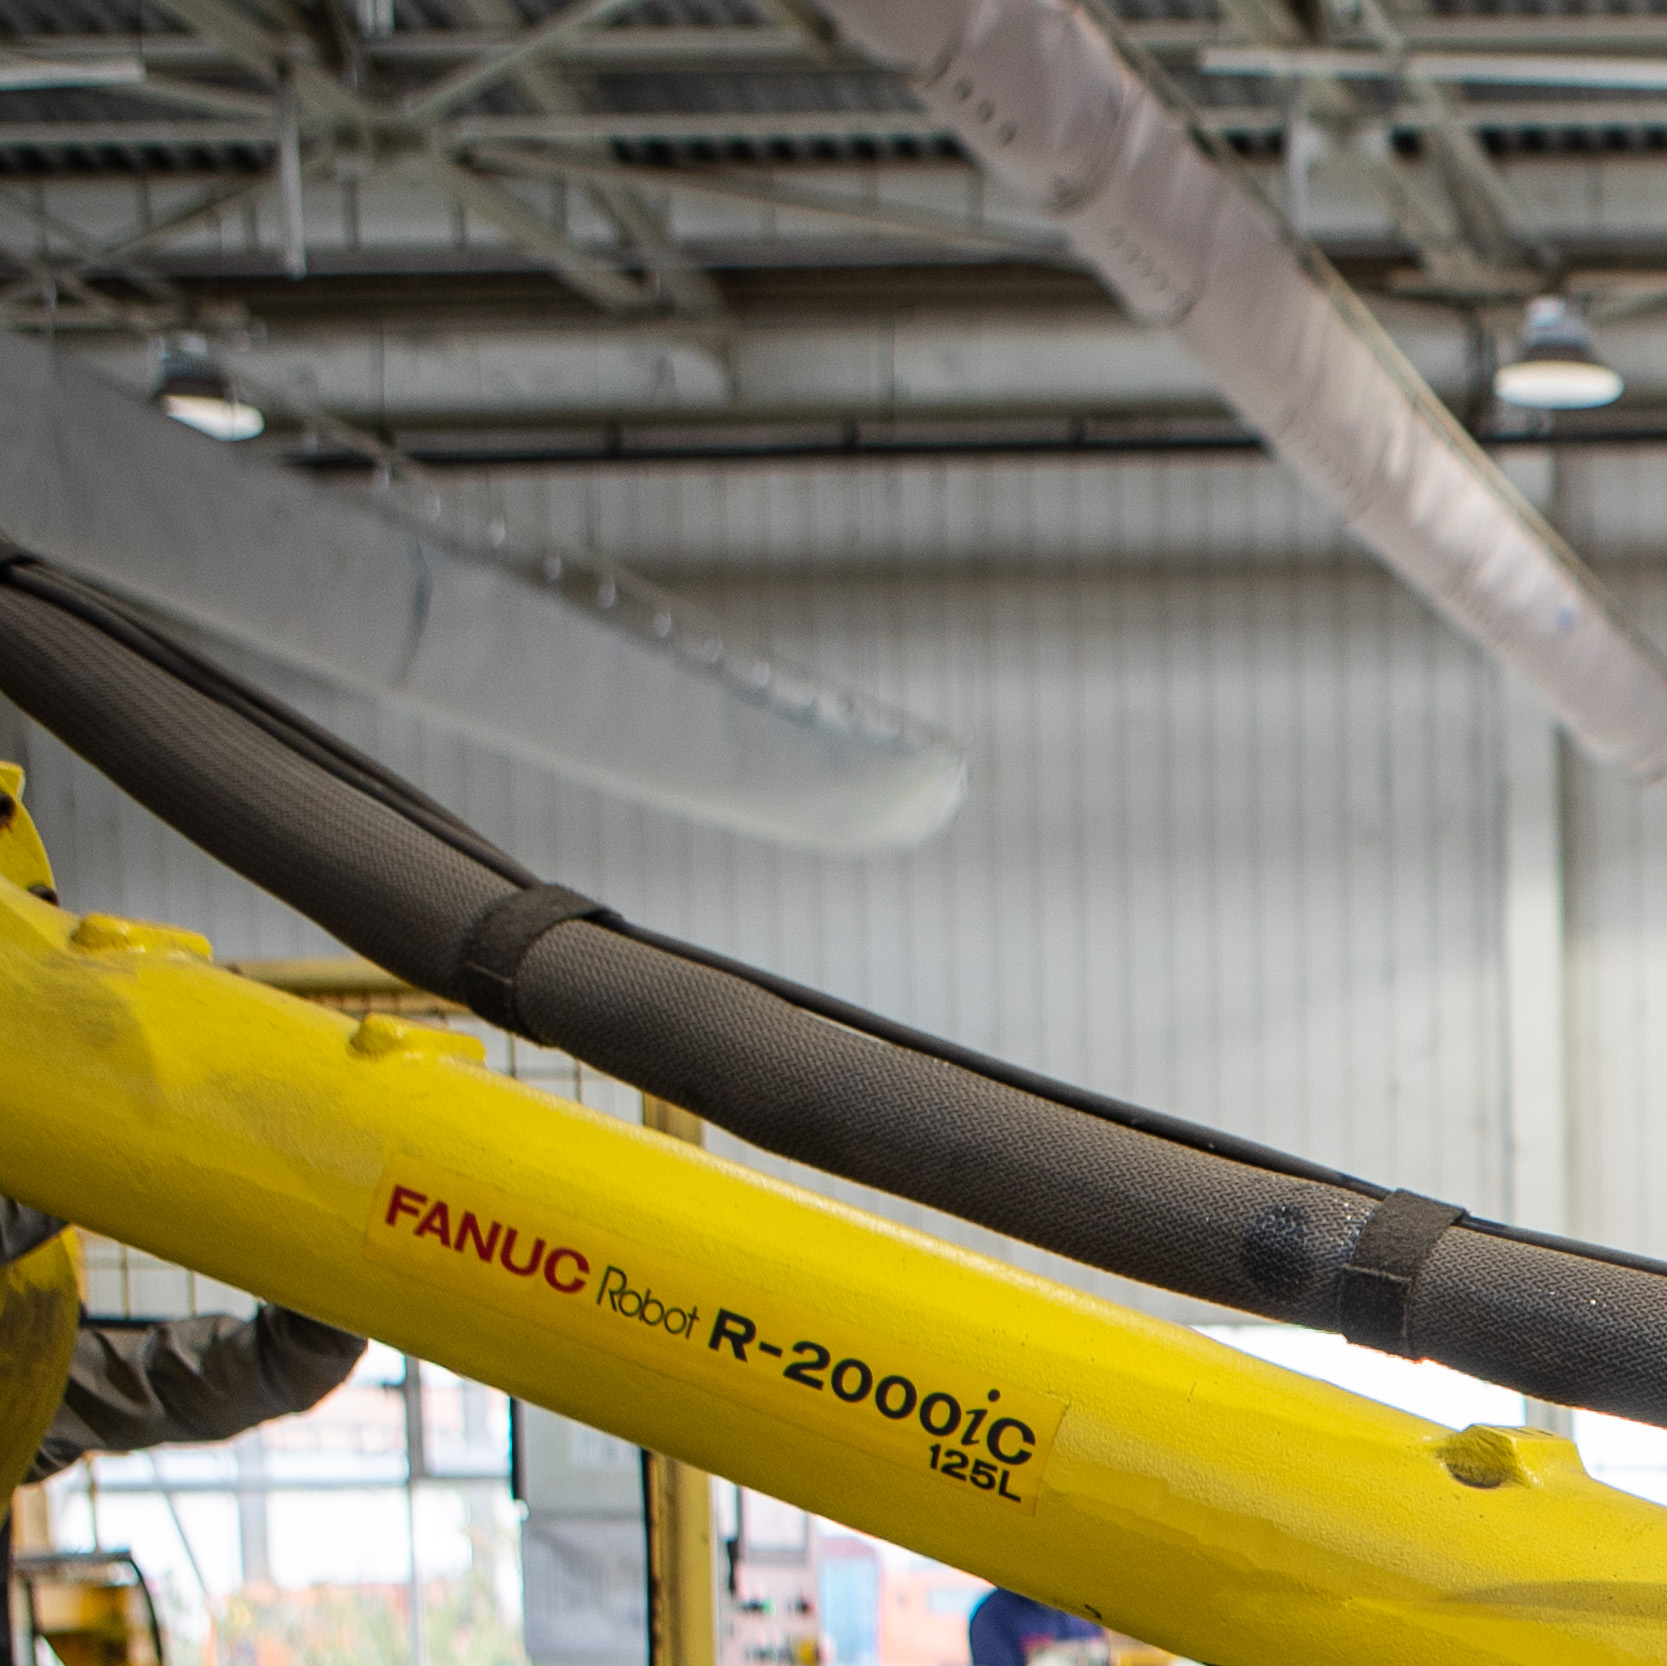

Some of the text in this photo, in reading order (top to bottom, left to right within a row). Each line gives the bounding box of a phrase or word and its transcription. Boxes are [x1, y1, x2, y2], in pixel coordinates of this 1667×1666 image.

[385, 1184, 1036, 1467] FANUC Robot R-2000iC
[928, 1442, 1022, 1504] 125L
